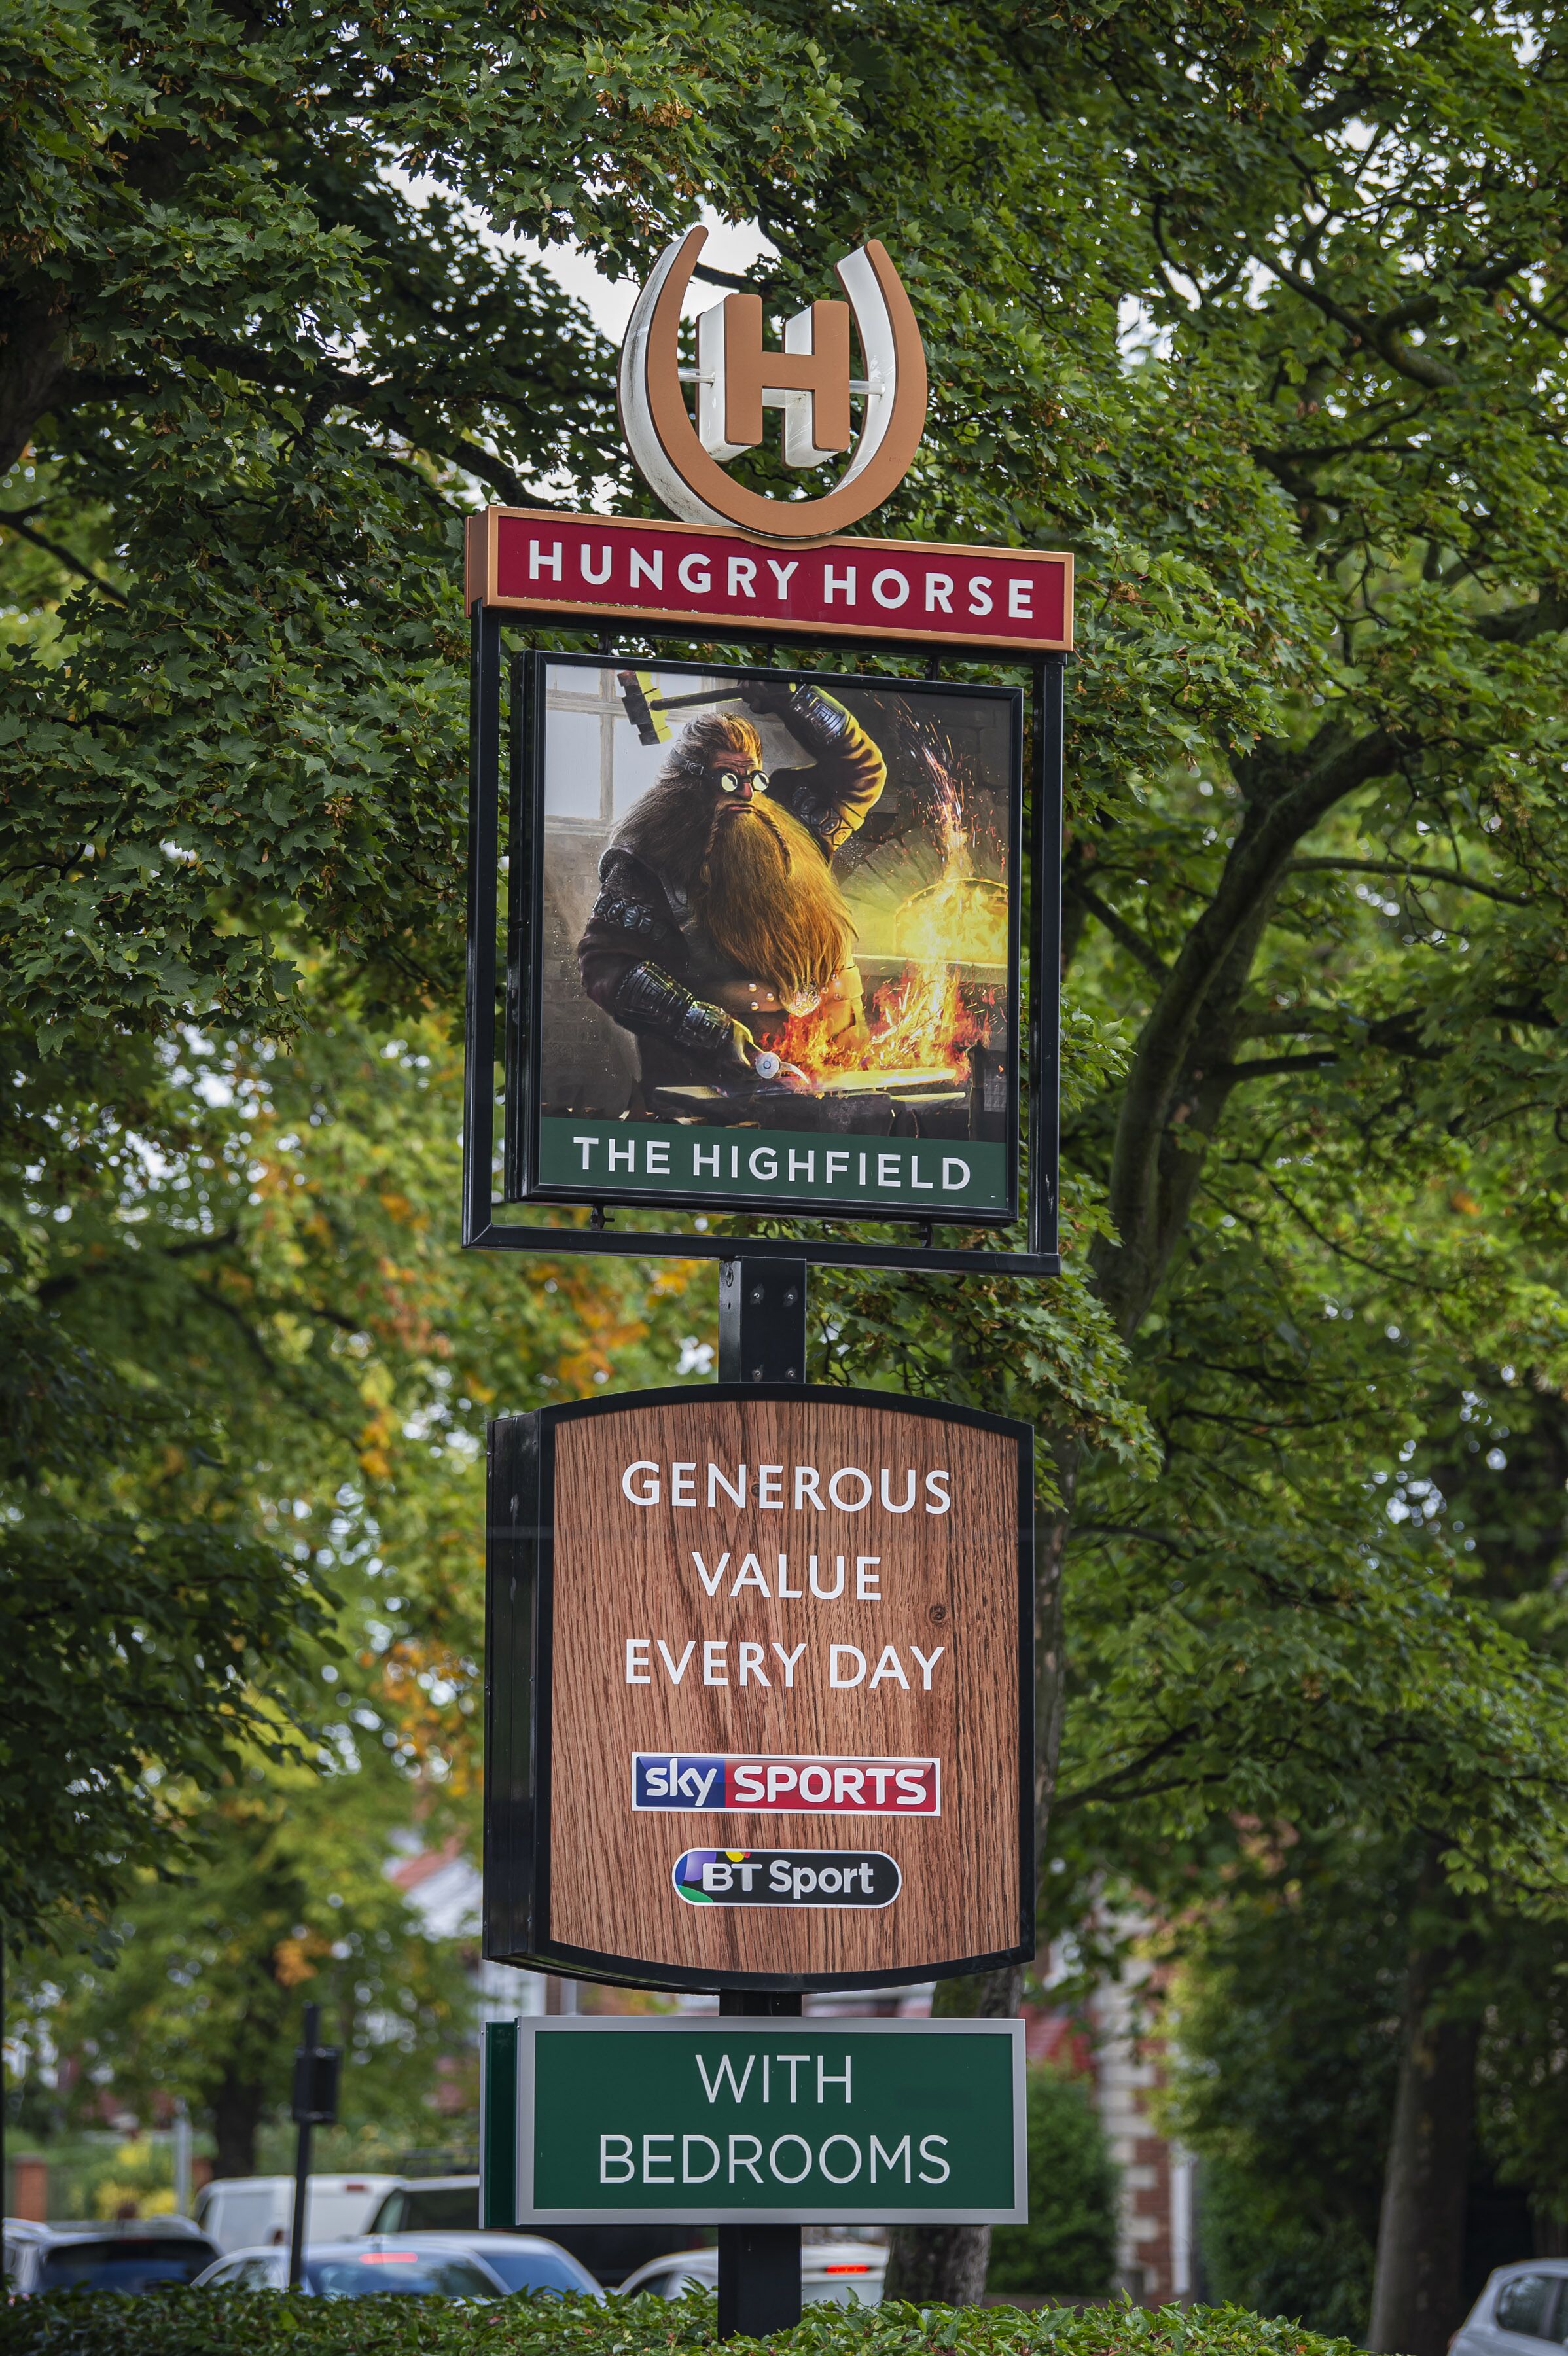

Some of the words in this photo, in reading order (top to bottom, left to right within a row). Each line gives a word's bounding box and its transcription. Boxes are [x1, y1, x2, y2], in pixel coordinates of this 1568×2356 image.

[724, 293, 850, 451] H
[529, 539, 798, 600] HUNGRY
[823, 564, 1033, 619] HORSE
[573, 1136, 671, 1175] THE
[692, 1143, 971, 1190] HIGHFIELD
[622, 1460, 951, 1515] GENEROUS
[692, 1552, 882, 1601] VALUE
[626, 1639, 807, 1688] EVERY
[830, 1643, 945, 1690] DAY
[645, 1758, 717, 1807] sky
[734, 1765, 926, 1806] SPORTS
[702, 1862, 762, 1892] BT
[769, 1859, 874, 1900] Sport
[695, 2054, 852, 2103] WITH
[600, 2134, 950, 2185] BEDROOMS
